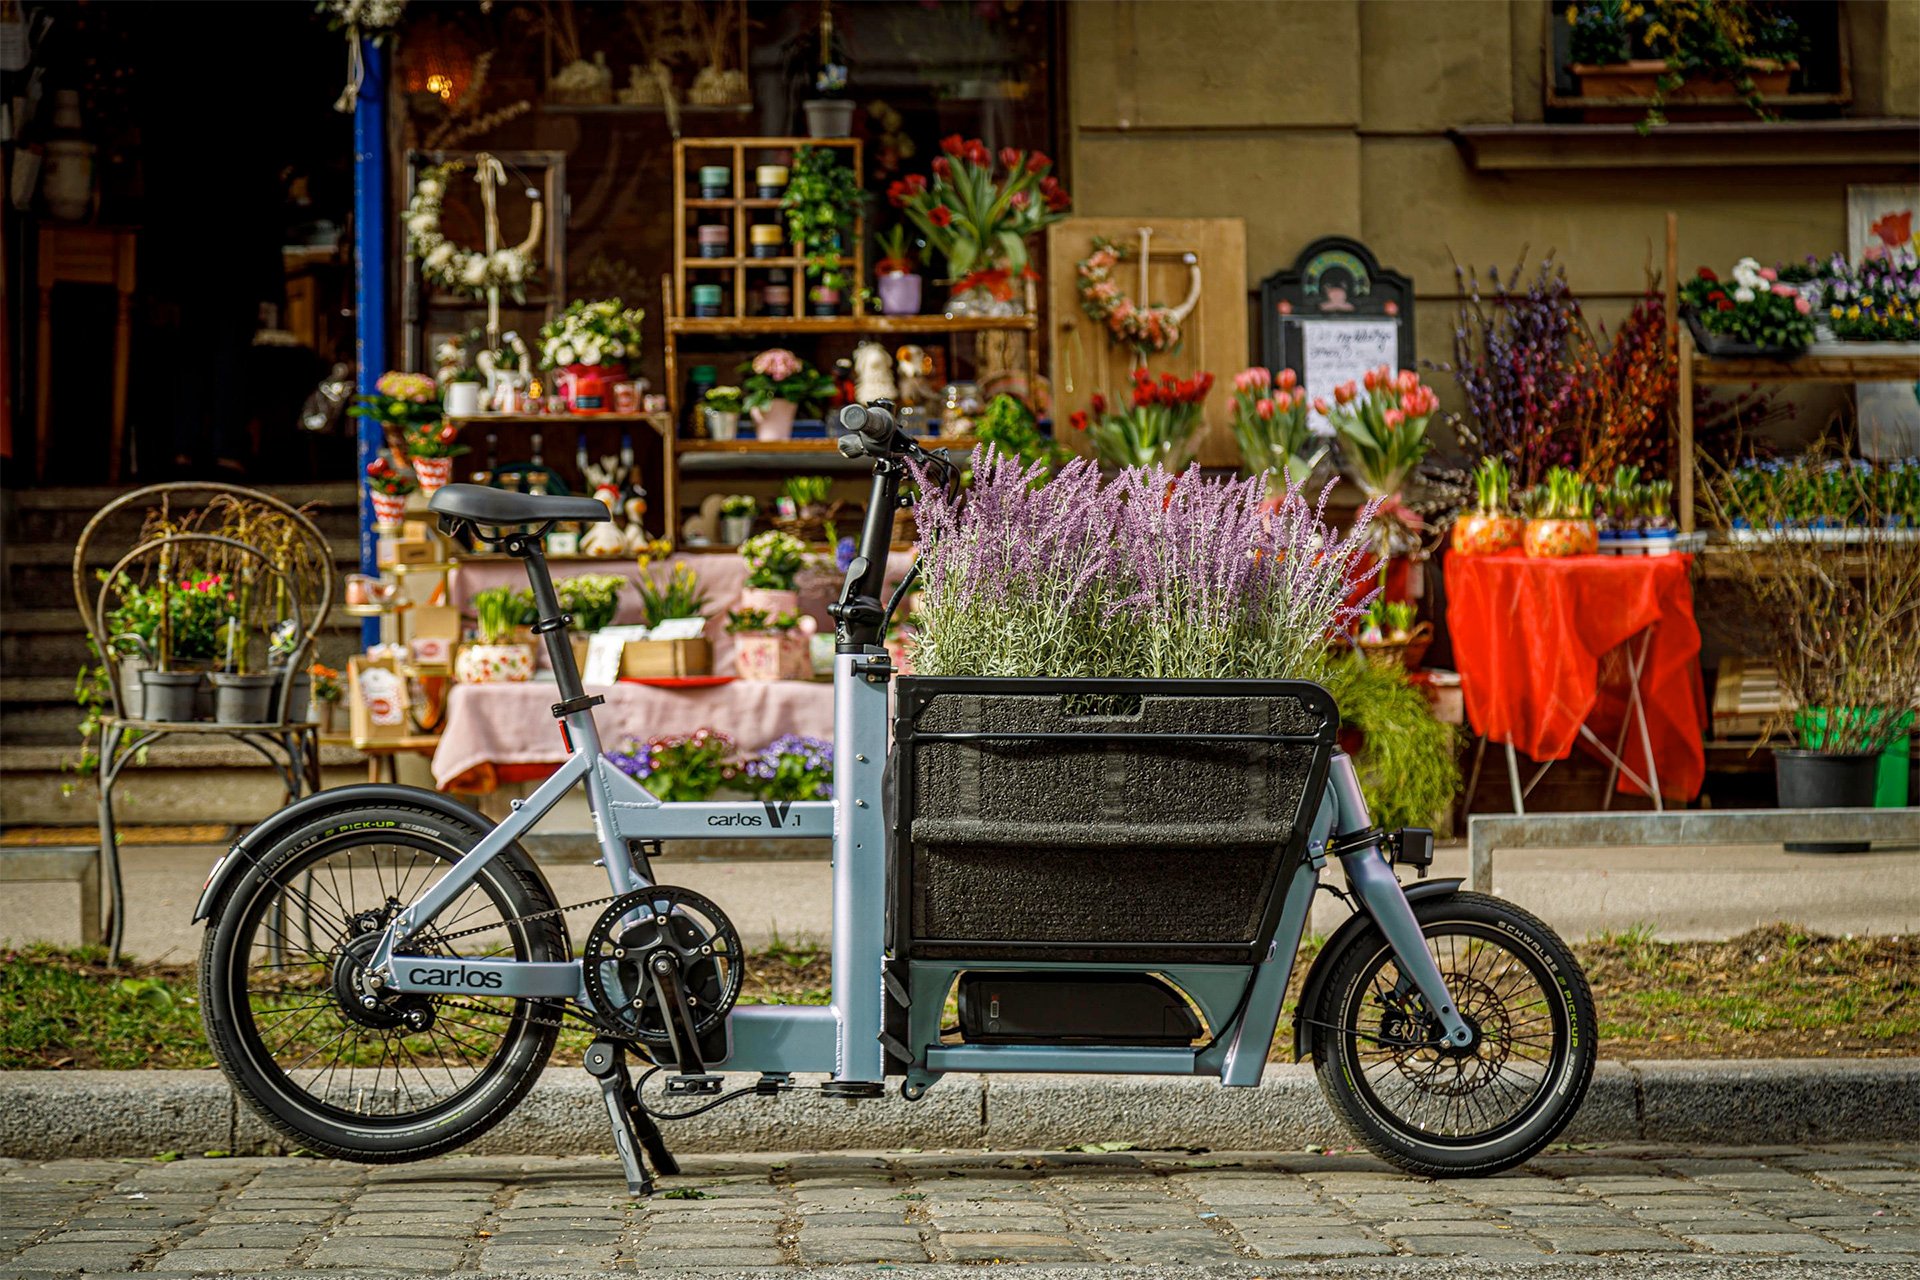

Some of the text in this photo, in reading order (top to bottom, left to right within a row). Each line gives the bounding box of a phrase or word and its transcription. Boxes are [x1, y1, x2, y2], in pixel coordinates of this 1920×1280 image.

[339, 821, 396, 832] PICK-UP
[1498, 921, 1559, 972] SCHWALBE
[1564, 990, 1578, 1048] PICK-UP
